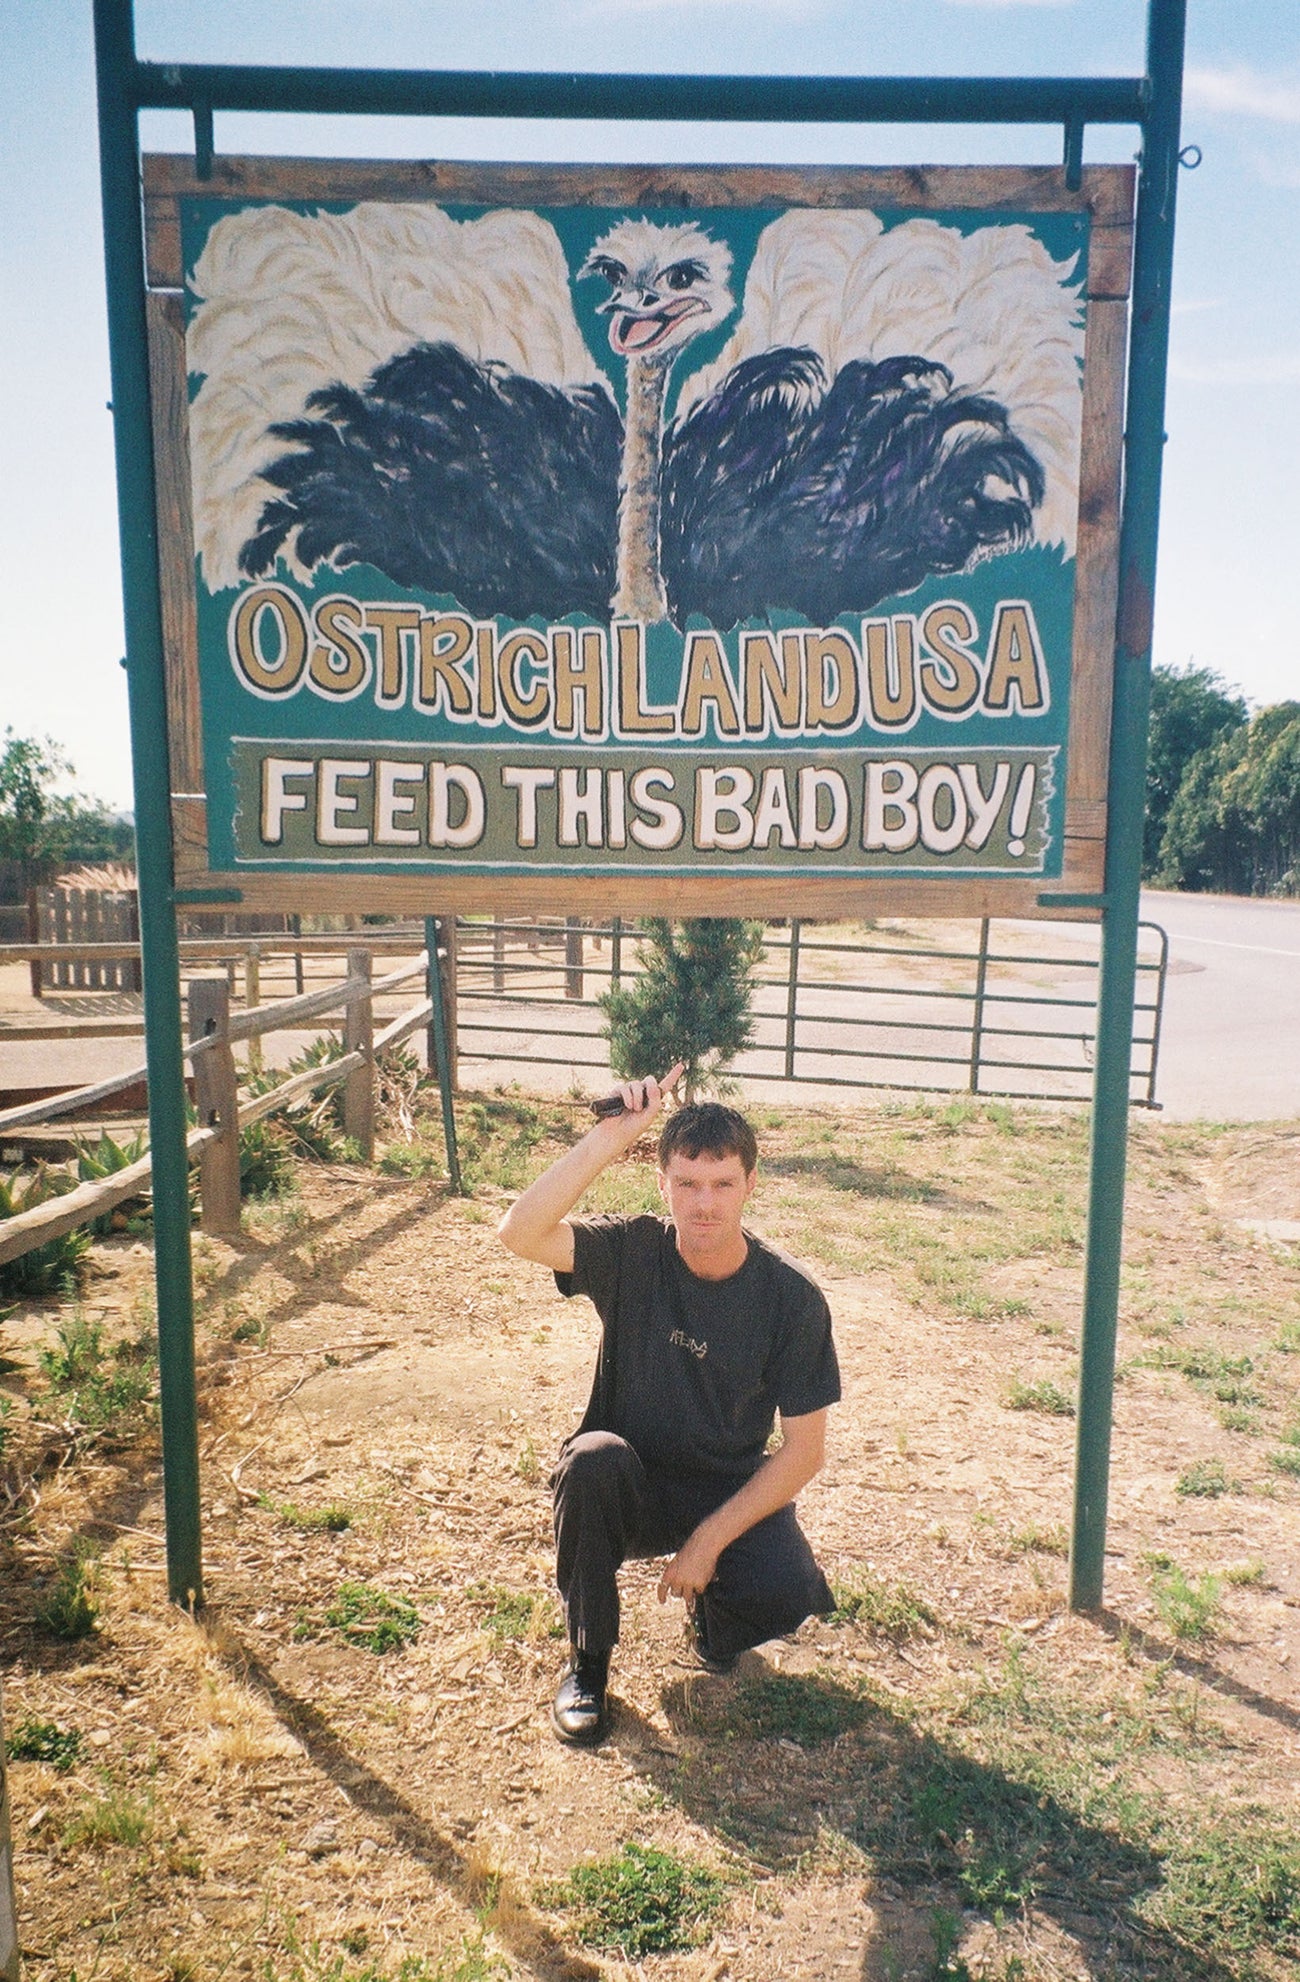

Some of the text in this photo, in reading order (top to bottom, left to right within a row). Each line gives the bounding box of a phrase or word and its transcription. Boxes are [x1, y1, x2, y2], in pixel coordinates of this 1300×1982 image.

[260, 756, 1036, 857] FEED THIS BAD BOY!
